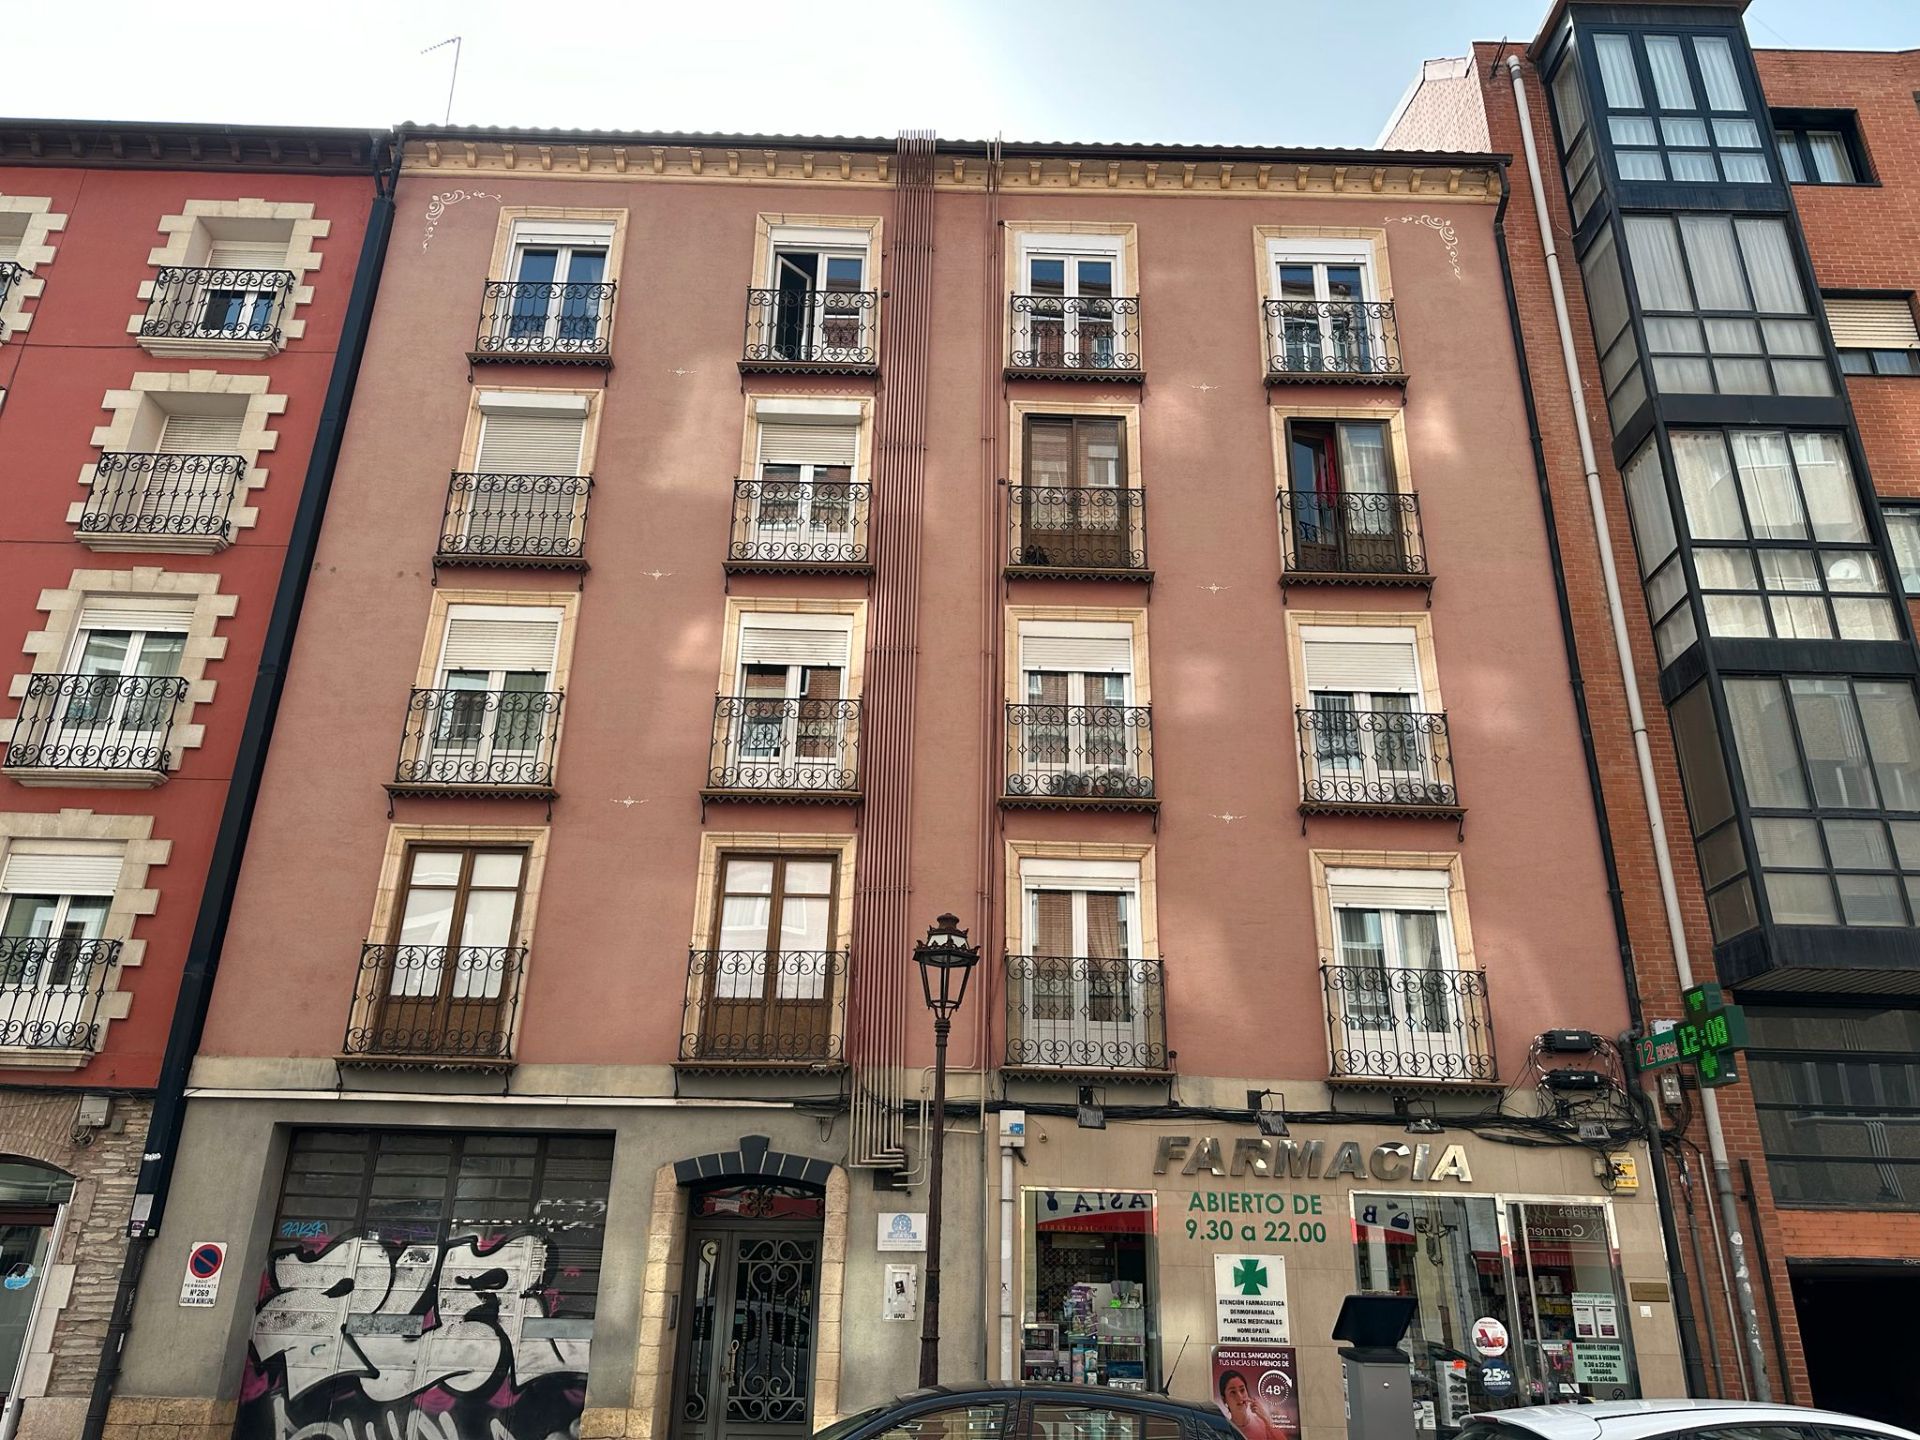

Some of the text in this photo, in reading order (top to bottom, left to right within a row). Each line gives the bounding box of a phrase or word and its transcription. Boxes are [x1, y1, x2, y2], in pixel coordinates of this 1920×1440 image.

[1679, 1015, 1728, 1056] 12:08
[1635, 1040, 1656, 1067] 12
[1153, 1135, 1473, 1182] FARMACIA
[1188, 1191, 1322, 1215] ABIERTO DE
[1185, 1219, 1327, 1243] 9.30 a 22.00
[1482, 1368, 1510, 1382] 25%
